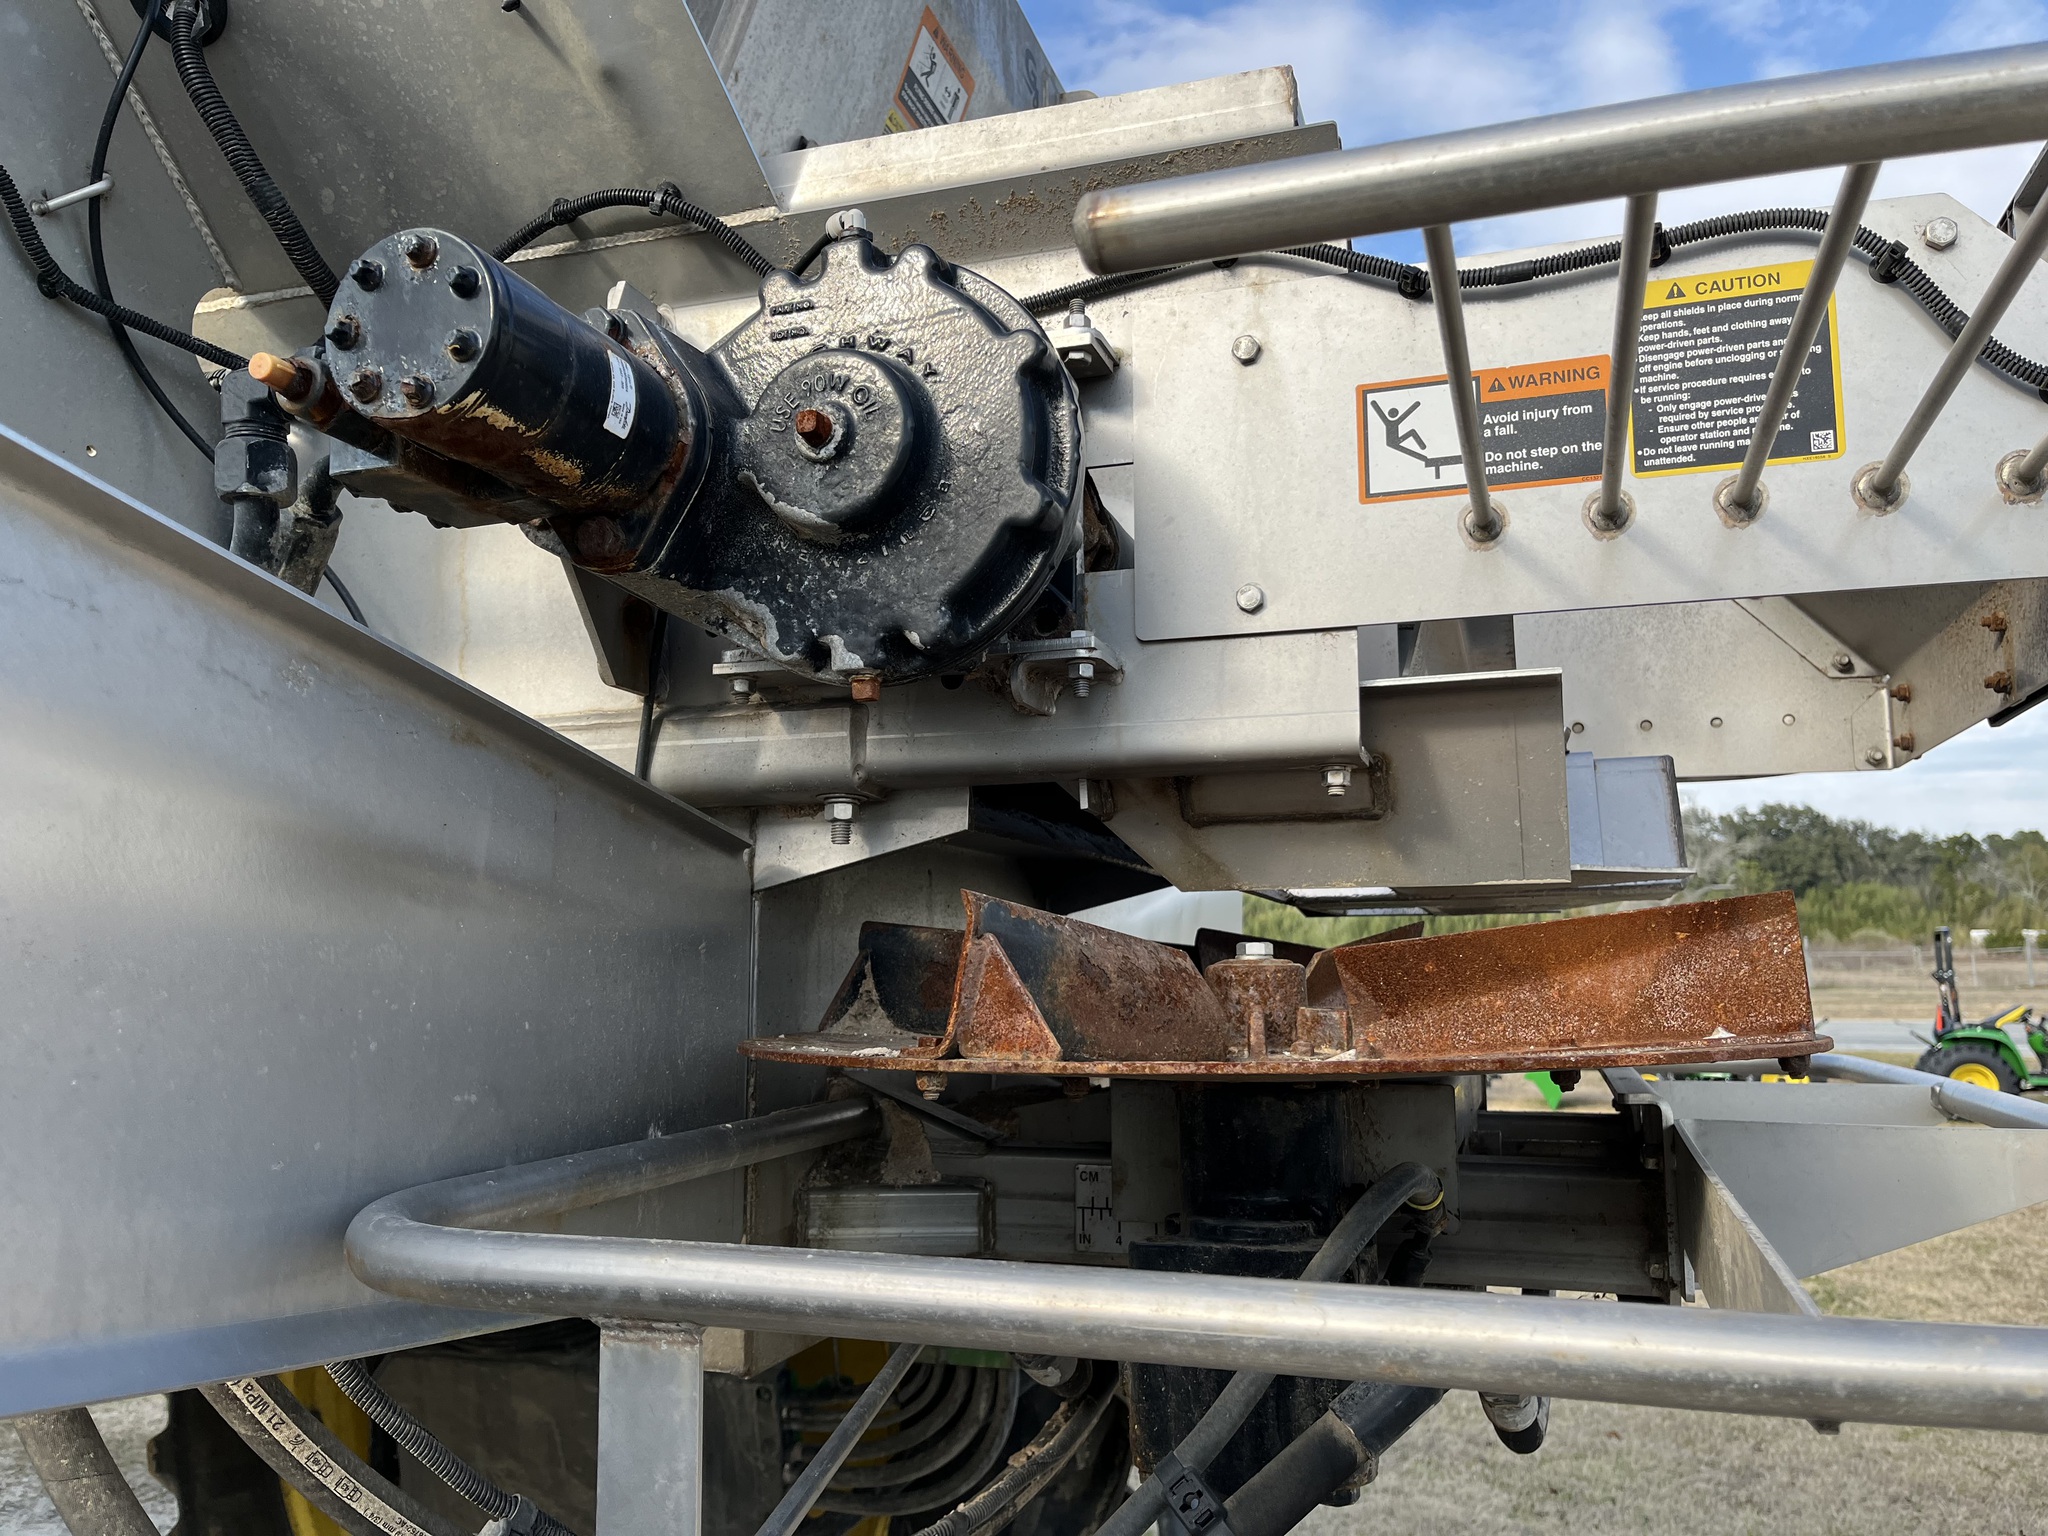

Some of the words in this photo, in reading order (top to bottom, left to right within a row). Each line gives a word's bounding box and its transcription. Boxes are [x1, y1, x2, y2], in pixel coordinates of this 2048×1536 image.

[1695, 272, 1780, 295] CAUTION
[1641, 312, 1659, 322] eep
[1660, 310, 1671, 318] all
[1673, 305, 1705, 317] shields
[1707, 304, 1716, 313] in
[1717, 301, 1742, 313] place
[1743, 297, 1773, 308] during
[1775, 293, 1803, 304] norma
[1638, 333, 1660, 342] Keep
[1661, 328, 1692, 340] hands,
[1693, 326, 1710, 336] feet
[1711, 323, 1729, 332] and
[1730, 319, 1767, 331] clothing
[1769, 316, 1792, 326] away
[1638, 339, 1695, 354] power-driven
[1696, 335, 1722, 347] parts.
[1638, 351, 1685, 363] Disengage
[1686, 343, 1744, 359] power-driven
[1746, 340, 1770, 351] parts
[1639, 364, 1651, 373] off
[1652, 361, 1683, 372] engine
[1684, 358, 1713, 368] before
[1715, 351, 1766, 364] unclogging
[1767, 350, 1778, 358] or
[1508, 366, 1600, 389] WARNING
[1639, 373, 1680, 384] machine.
[1640, 385, 1646, 394] If
[1647, 382, 1680, 393] service
[1681, 377, 1727, 391] procedure
[1729, 372, 1767, 384] requires
[1801, 367, 1811, 375] to
[1640, 396, 1652, 404] be
[1653, 392, 1691, 403] running:
[1656, 403, 1677, 413] Only
[1678, 400, 1712, 411] engage
[1713, 393, 1767, 408] power-drive
[770, 391, 800, 432] USE
[853, 384, 881, 421] OIL
[1483, 410, 1519, 425] Avoid
[1522, 407, 1559, 422] injury
[1562, 404, 1593, 416] from
[1658, 411, 1696, 423] required
[1697, 410, 1709, 420] by
[1711, 406, 1744, 417] service
[1483, 428, 1491, 437] a
[1494, 424, 1518, 436] fall.
[1657, 424, 1689, 434] Ensure
[1690, 420, 1714, 430] other
[1716, 417, 1747, 429] people
[1790, 410, 1800, 419] of
[1660, 433, 1698, 445] operator
[1699, 430, 1731, 440] station
[1732, 427, 1750, 436] and
[1485, 451, 1503, 463] Do
[1506, 448, 1528, 460] not
[1530, 446, 1558, 458] step
[1561, 444, 1579, 454] on
[1581, 440, 1603, 452] the
[1643, 447, 1656, 456] Do
[1657, 446, 1673, 454] not
[1674, 443, 1698, 453] leave
[1699, 439, 1735, 450] running
[1485, 460, 1544, 475] machine.
[1643, 453, 1696, 466] unattended.
[1079, 1170, 1099, 1182] CM
[1078, 1233, 1091, 1245] IN
[1115, 1235, 1122, 1246] 4
[242, 1382, 270, 1416] MPa
[266, 1412, 286, 1431] 21
[381, 1521, 396, 1533] mm
